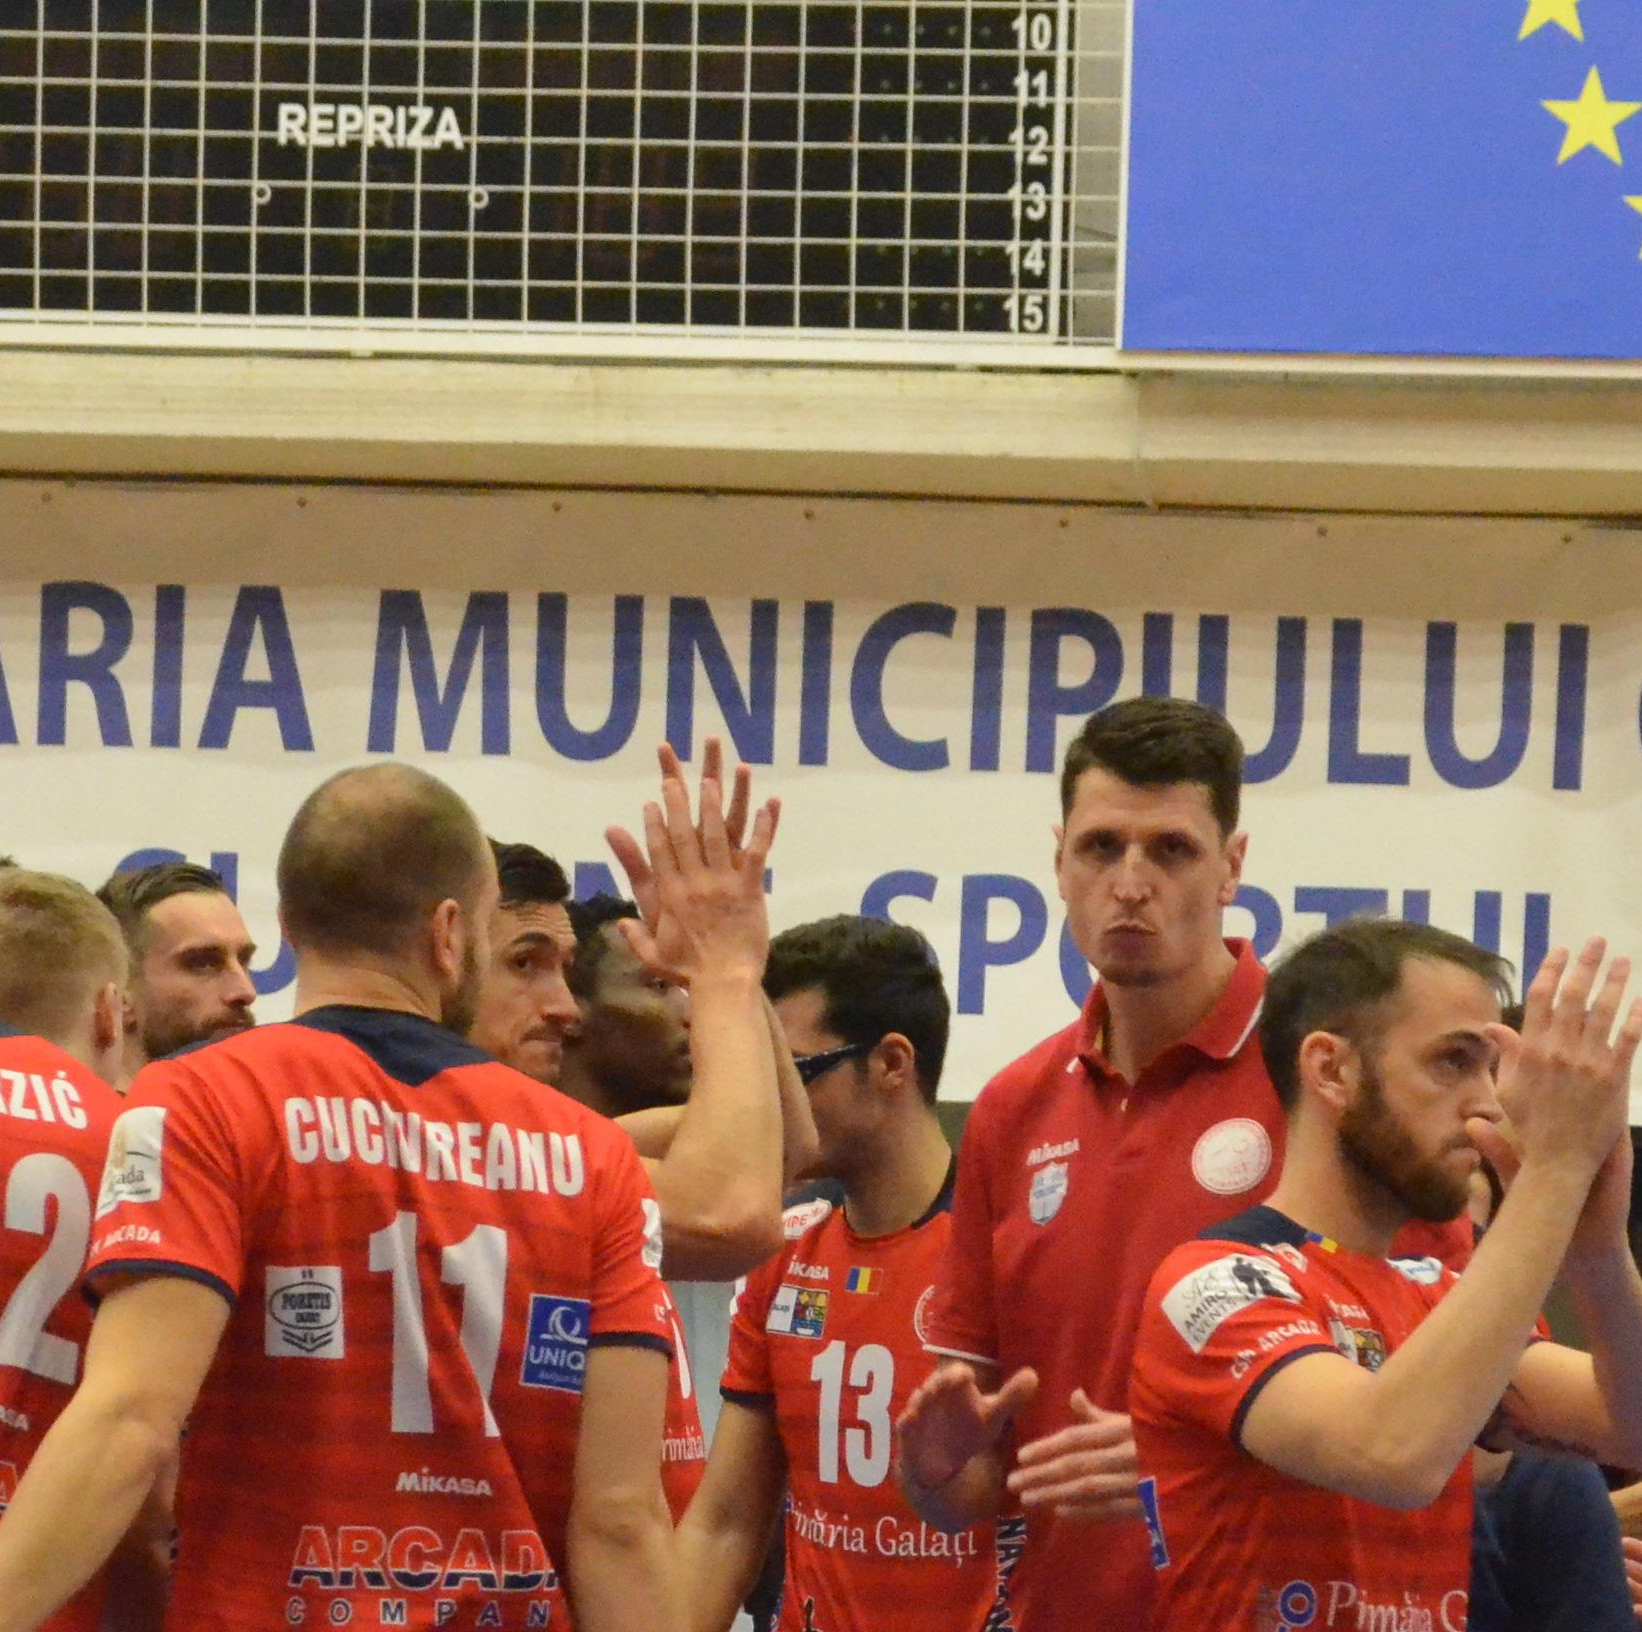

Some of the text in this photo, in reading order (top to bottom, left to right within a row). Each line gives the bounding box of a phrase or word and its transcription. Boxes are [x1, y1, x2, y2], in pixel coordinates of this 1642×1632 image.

[1010, 13, 1053, 50] 10
[1012, 69, 1048, 108] 11
[277, 102, 464, 150] REPRIZA
[1007, 125, 1049, 165] 12
[1007, 181, 1047, 221] 13
[1005, 238, 1045, 277] 14
[1002, 295, 1044, 333] 15
[366, 588, 1590, 794] MUNICIPIULUI
[369, 1210, 508, 1438] 11
[1182, 1288, 1228, 1333] AMIRO
[528, 1346, 587, 1374] UNIQ
[1230, 1319, 1322, 1381] CSM ARCADA
[811, 1339, 895, 1488] 13
[287, 1524, 559, 1592] ARCAD
[285, 1596, 554, 1628] COMPAN
